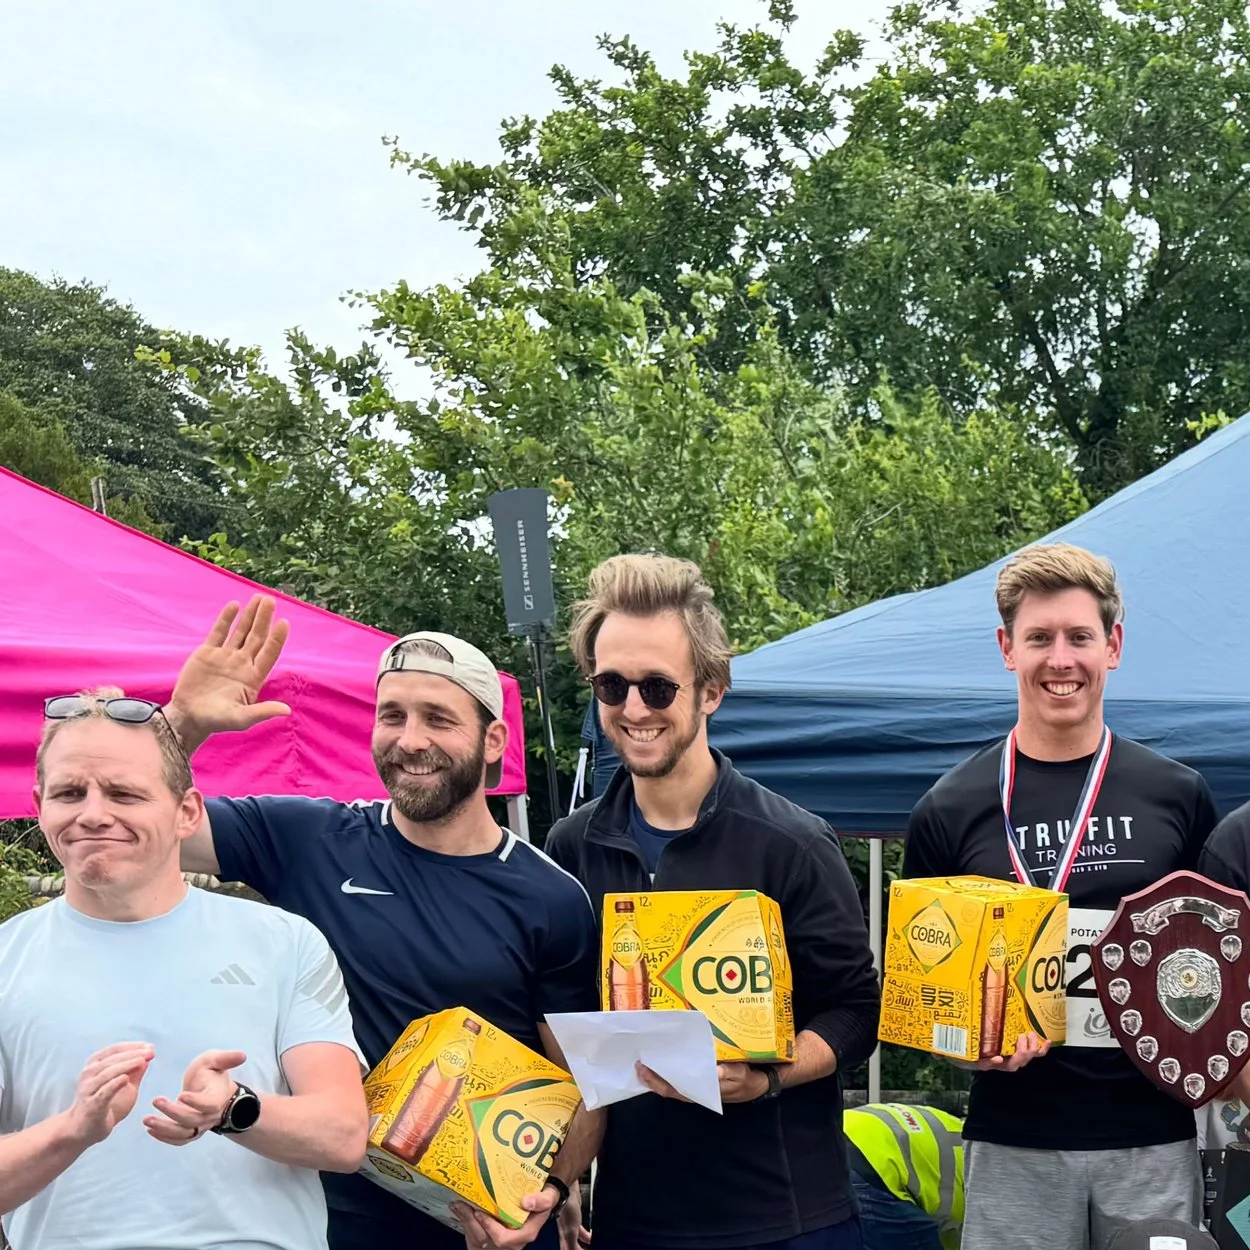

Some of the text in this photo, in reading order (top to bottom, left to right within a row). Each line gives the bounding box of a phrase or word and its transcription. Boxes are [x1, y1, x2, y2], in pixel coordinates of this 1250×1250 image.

[517, 519, 531, 592] SENNHEISER
[1036, 843, 1117, 862] TRNING
[911, 925, 952, 947] COBRA
[1071, 928, 1103, 938] POTA
[612, 941, 640, 953] COBRA
[692, 956, 773, 995] COB
[439, 1049, 468, 1070] COBRA
[492, 1109, 561, 1173] COB
